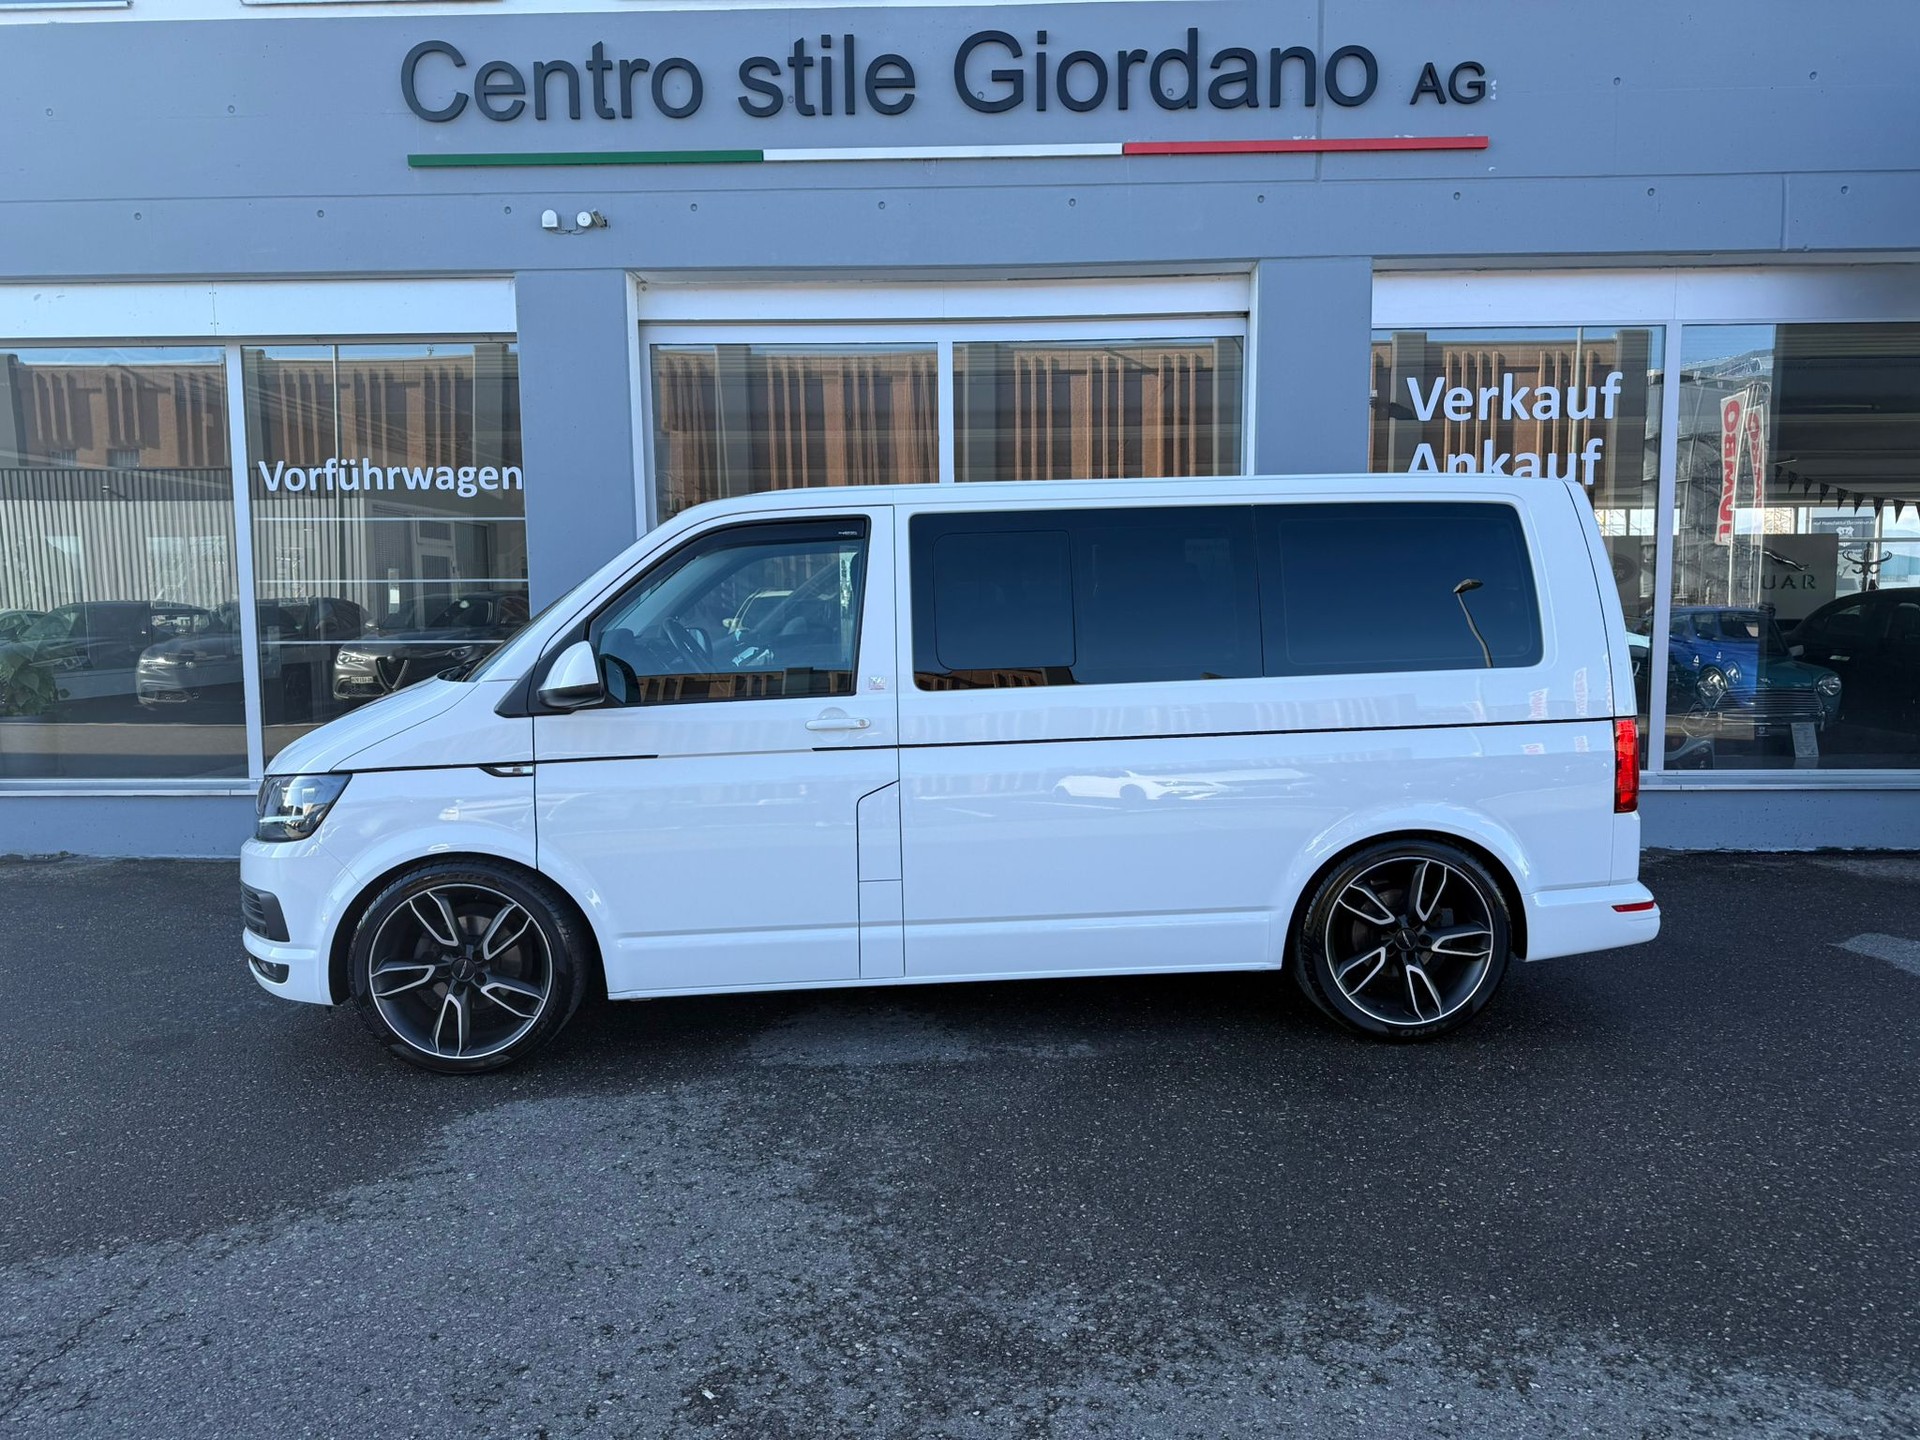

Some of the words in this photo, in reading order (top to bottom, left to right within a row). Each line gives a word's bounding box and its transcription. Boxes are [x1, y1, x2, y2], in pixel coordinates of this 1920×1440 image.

[401, 40, 704, 123] Centro
[738, 34, 916, 118] stile
[953, 27, 1379, 114] Giordano
[1409, 61, 1487, 105] AG
[1406, 371, 1623, 422] Verkauf
[258, 458, 524, 498] Vorführwagen
[1407, 438, 1604, 485] Ankauf
